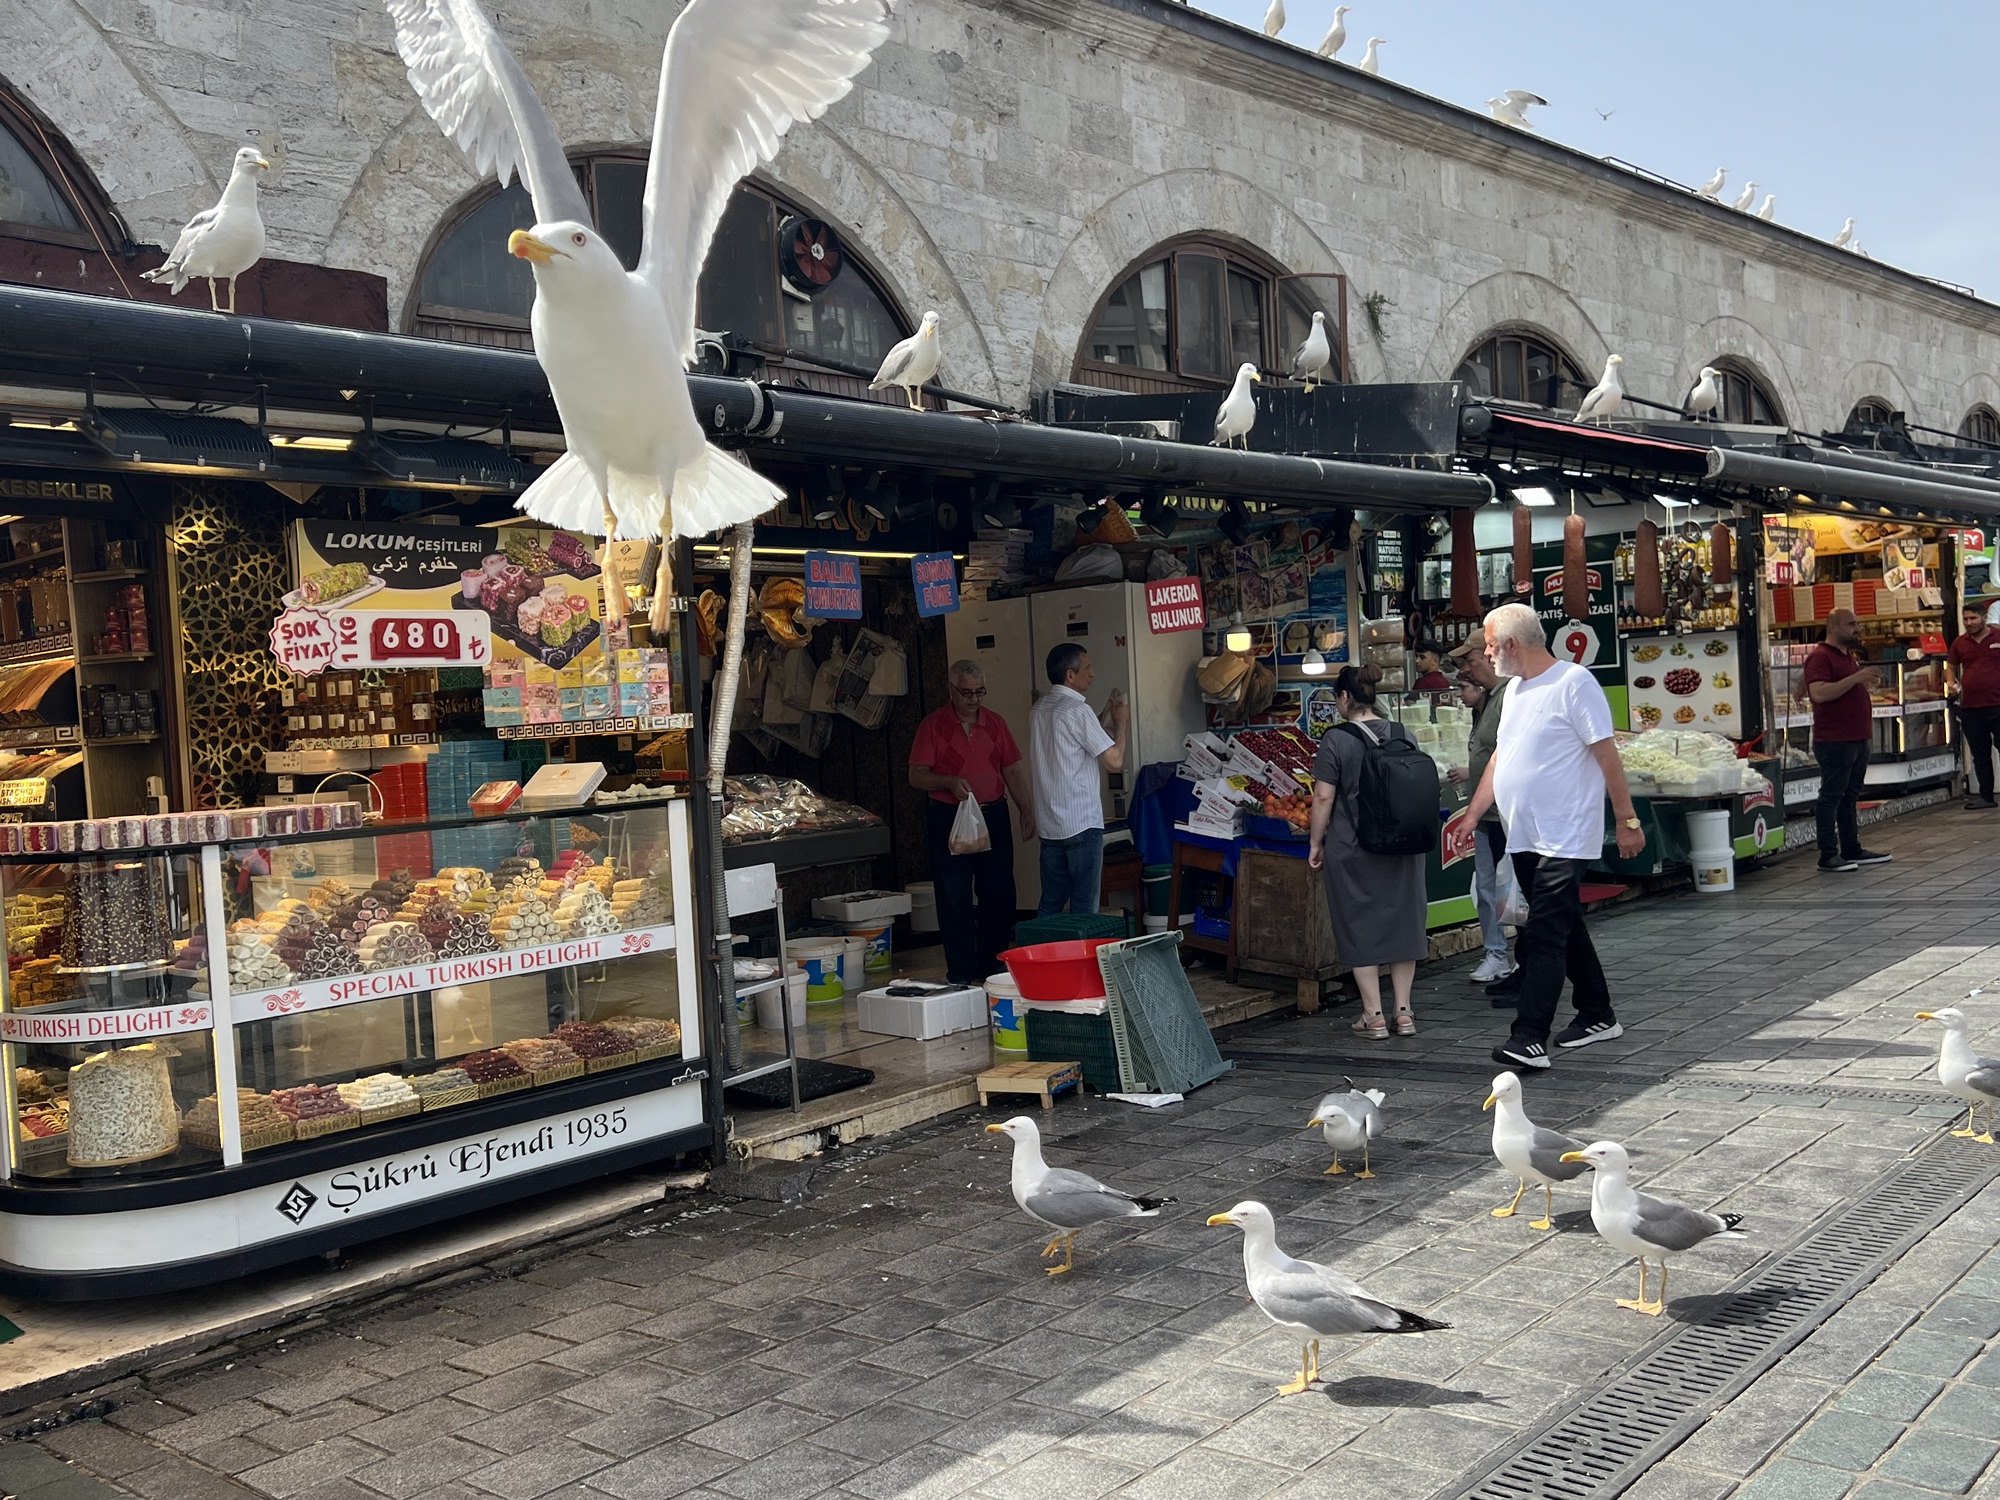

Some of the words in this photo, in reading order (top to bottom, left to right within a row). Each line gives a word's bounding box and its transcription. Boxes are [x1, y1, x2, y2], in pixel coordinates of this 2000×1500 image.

[325, 532, 416, 551] LOKUM
[416, 538, 482, 554] ÇEŞİTLERİ
[418, 556, 458, 575] حلقوم
[810, 559, 857, 584] BALIK
[915, 558, 953, 584] SOMON
[806, 586, 862, 611] YUMURTASI
[922, 582, 953, 609] FÜME
[1149, 583, 1199, 607] LAKERDA
[340, 616, 357, 646] KG
[1151, 606, 1203, 630] BULUNUR
[280, 619, 322, 645] ŞOK
[382, 621, 450, 649] 680
[283, 641, 331, 663] FİYAT
[341, 653, 359, 662] 1
[1565, 631, 1588, 664] 9
[329, 970, 421, 1001] SPECIAL
[425, 954, 513, 986] TURKISH
[519, 939, 602, 970] DELIGHT
[17, 1017, 81, 1038] TURKISH
[88, 1009, 174, 1036] DELIGHT
[327, 1153, 439, 1214] Şükrü
[448, 1126, 556, 1179] Efendi
[563, 1106, 629, 1147] 1935
